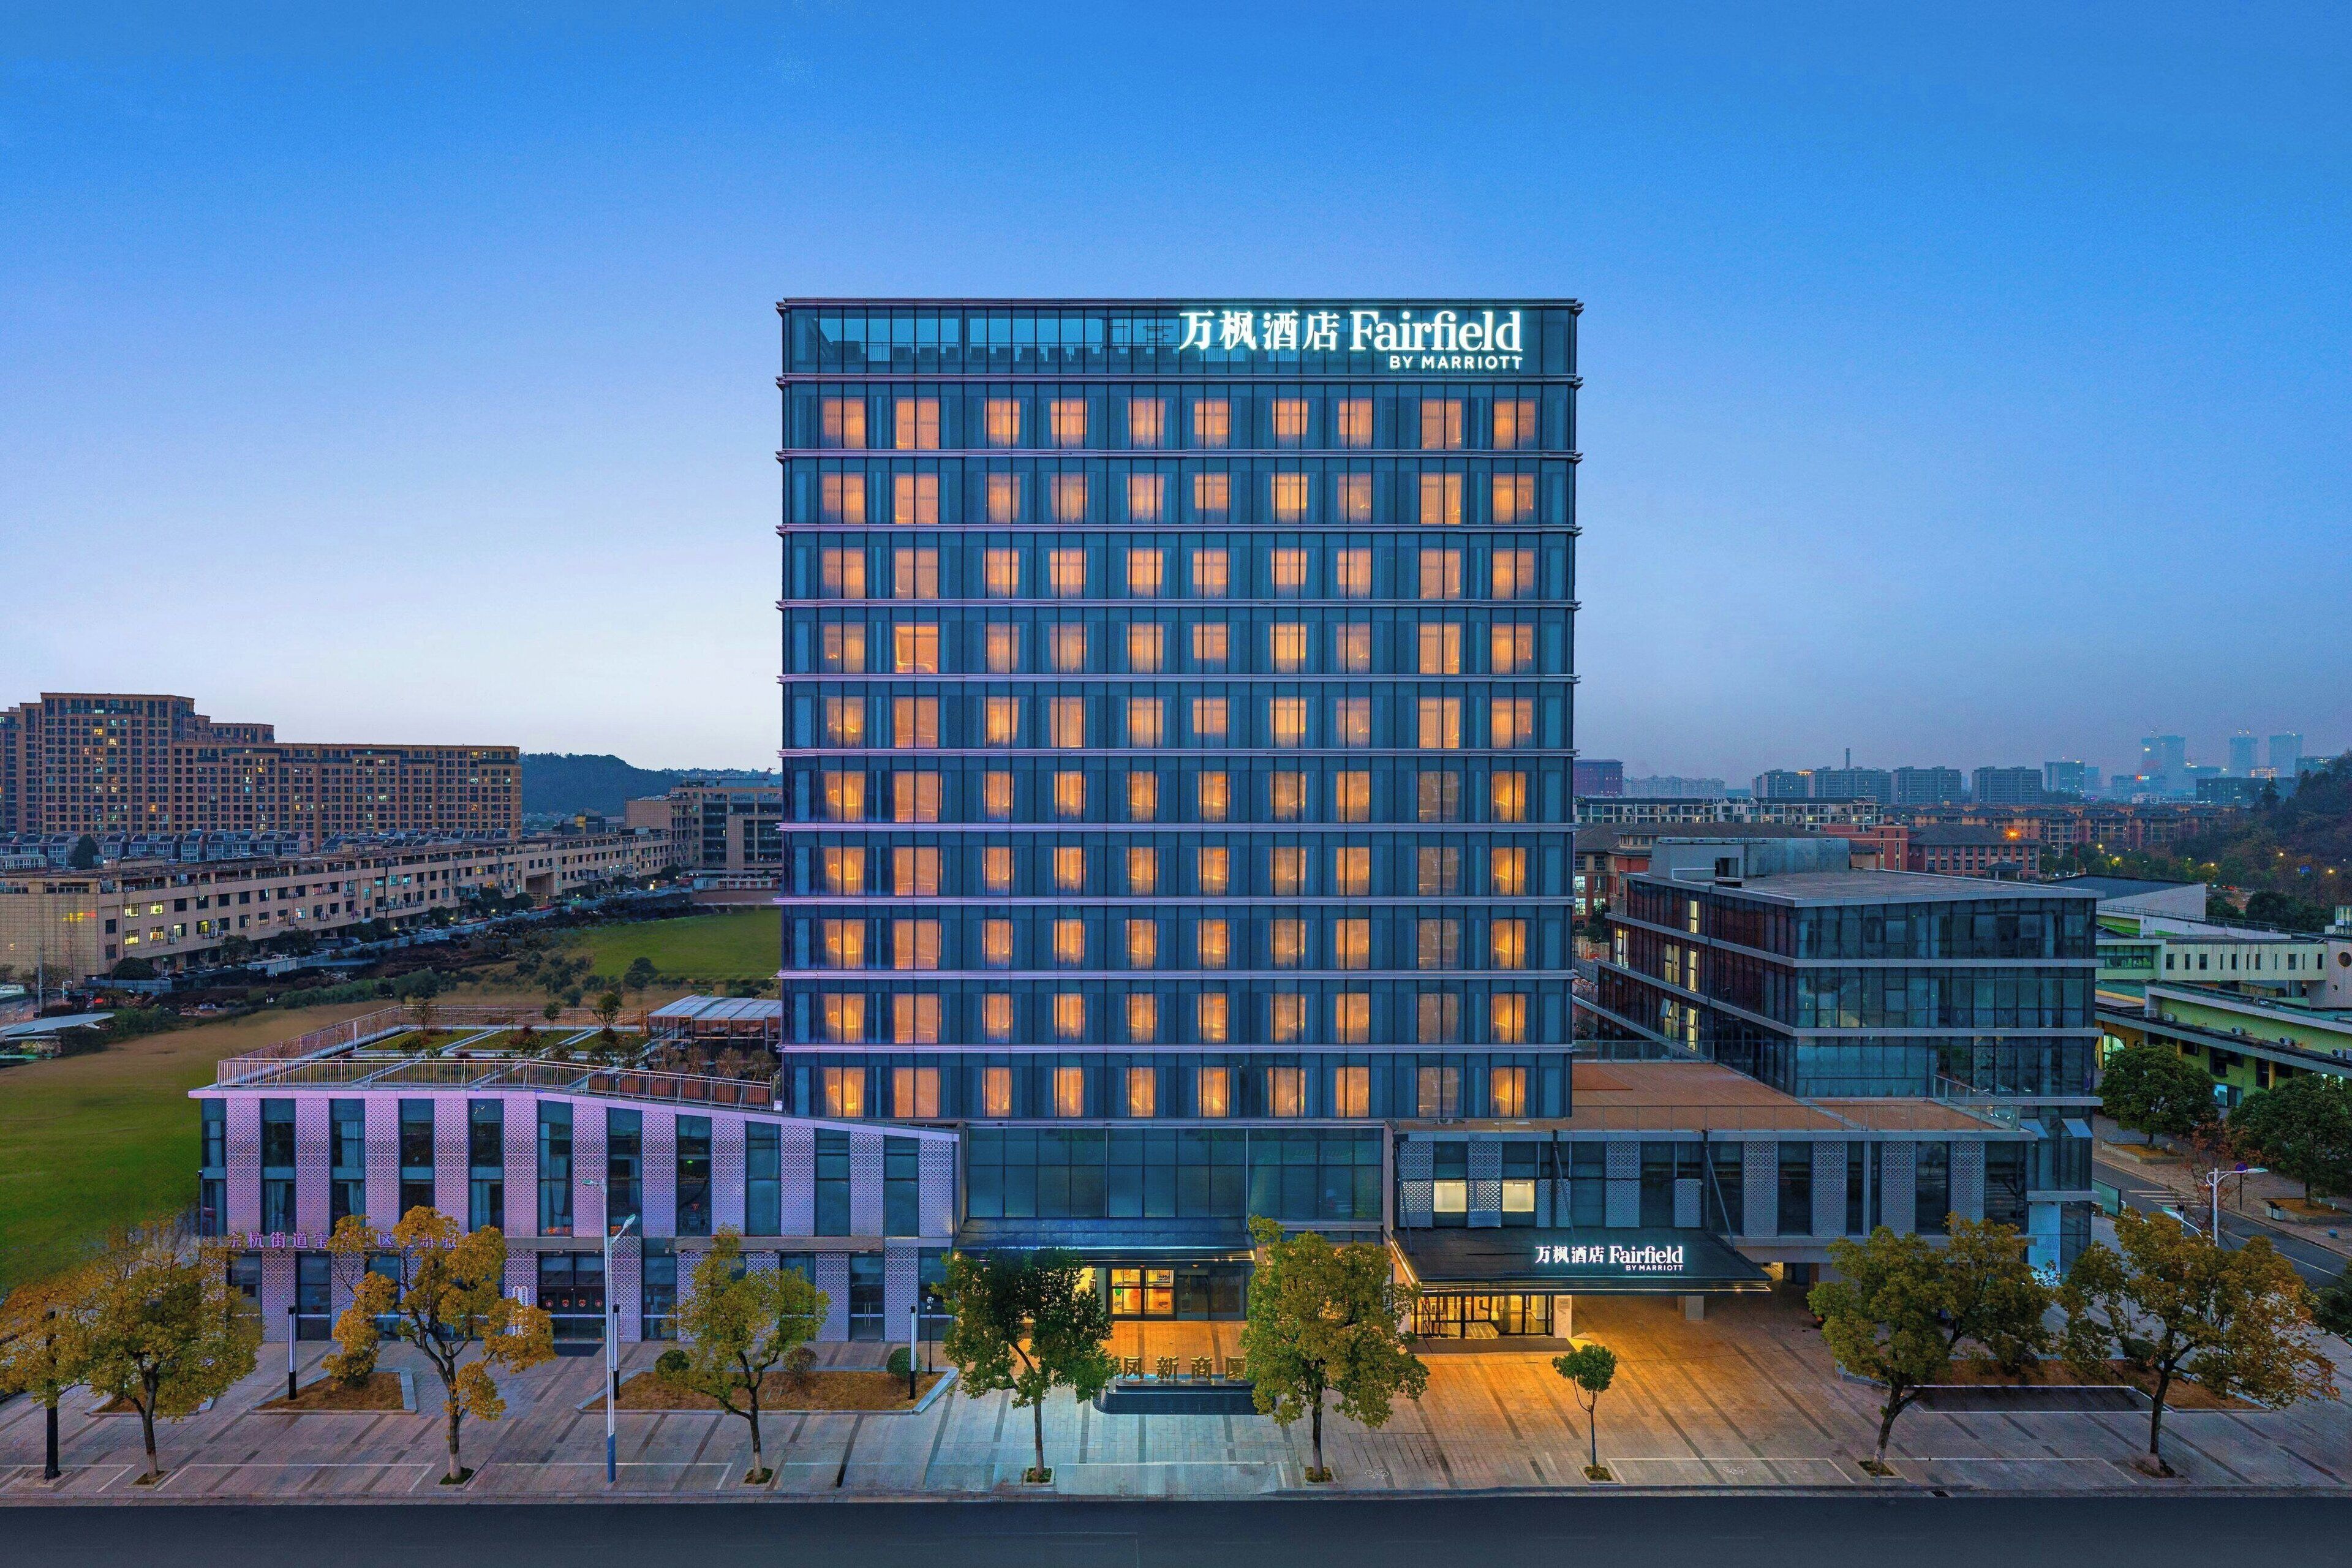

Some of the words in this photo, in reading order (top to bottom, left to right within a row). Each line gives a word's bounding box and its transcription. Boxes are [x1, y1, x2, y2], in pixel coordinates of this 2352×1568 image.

[1179, 311, 1340, 351] 万枫酒店
[1349, 311, 1523, 352] Fairfield
[1389, 355, 1413, 369] BY
[1421, 355, 1523, 369] MARRIOTT
[1535, 1245, 1605, 1264] 万枫酒店
[1608, 1245, 1684, 1264] Fairfield
